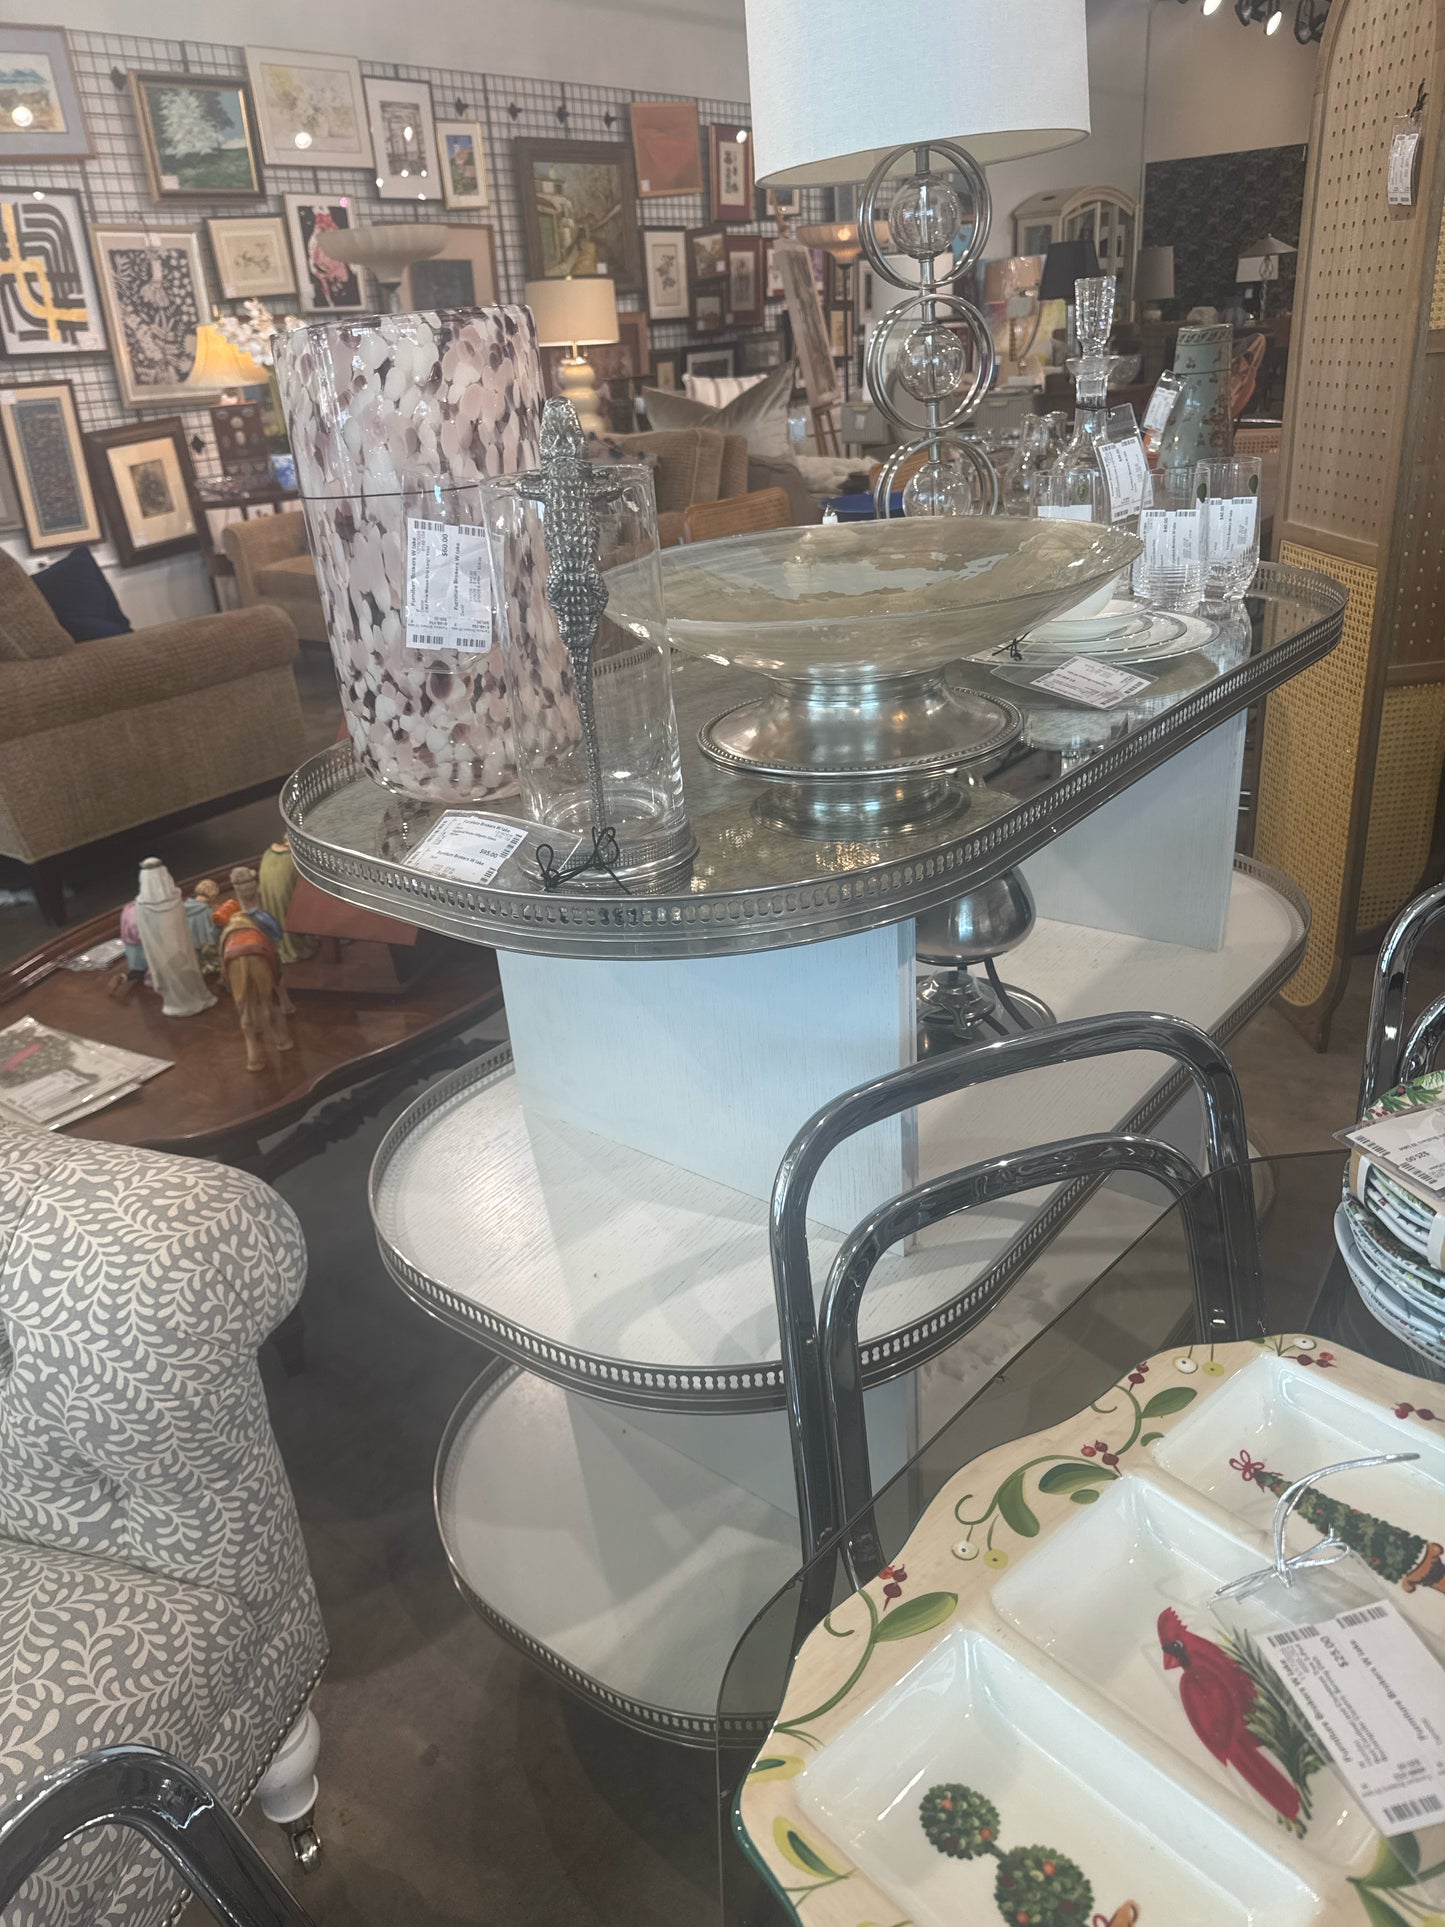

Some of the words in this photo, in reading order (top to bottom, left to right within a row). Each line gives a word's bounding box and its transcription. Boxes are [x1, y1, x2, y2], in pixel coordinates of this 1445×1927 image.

[479, 849, 499, 858] $95.00
[1319, 1634, 1350, 1669] $25.00
[1360, 1655, 1374, 1667] W
[1289, 1676, 1302, 1687] W
[1369, 1666, 1398, 1700] Brokers
[1297, 1687, 1325, 1721] Brokers
